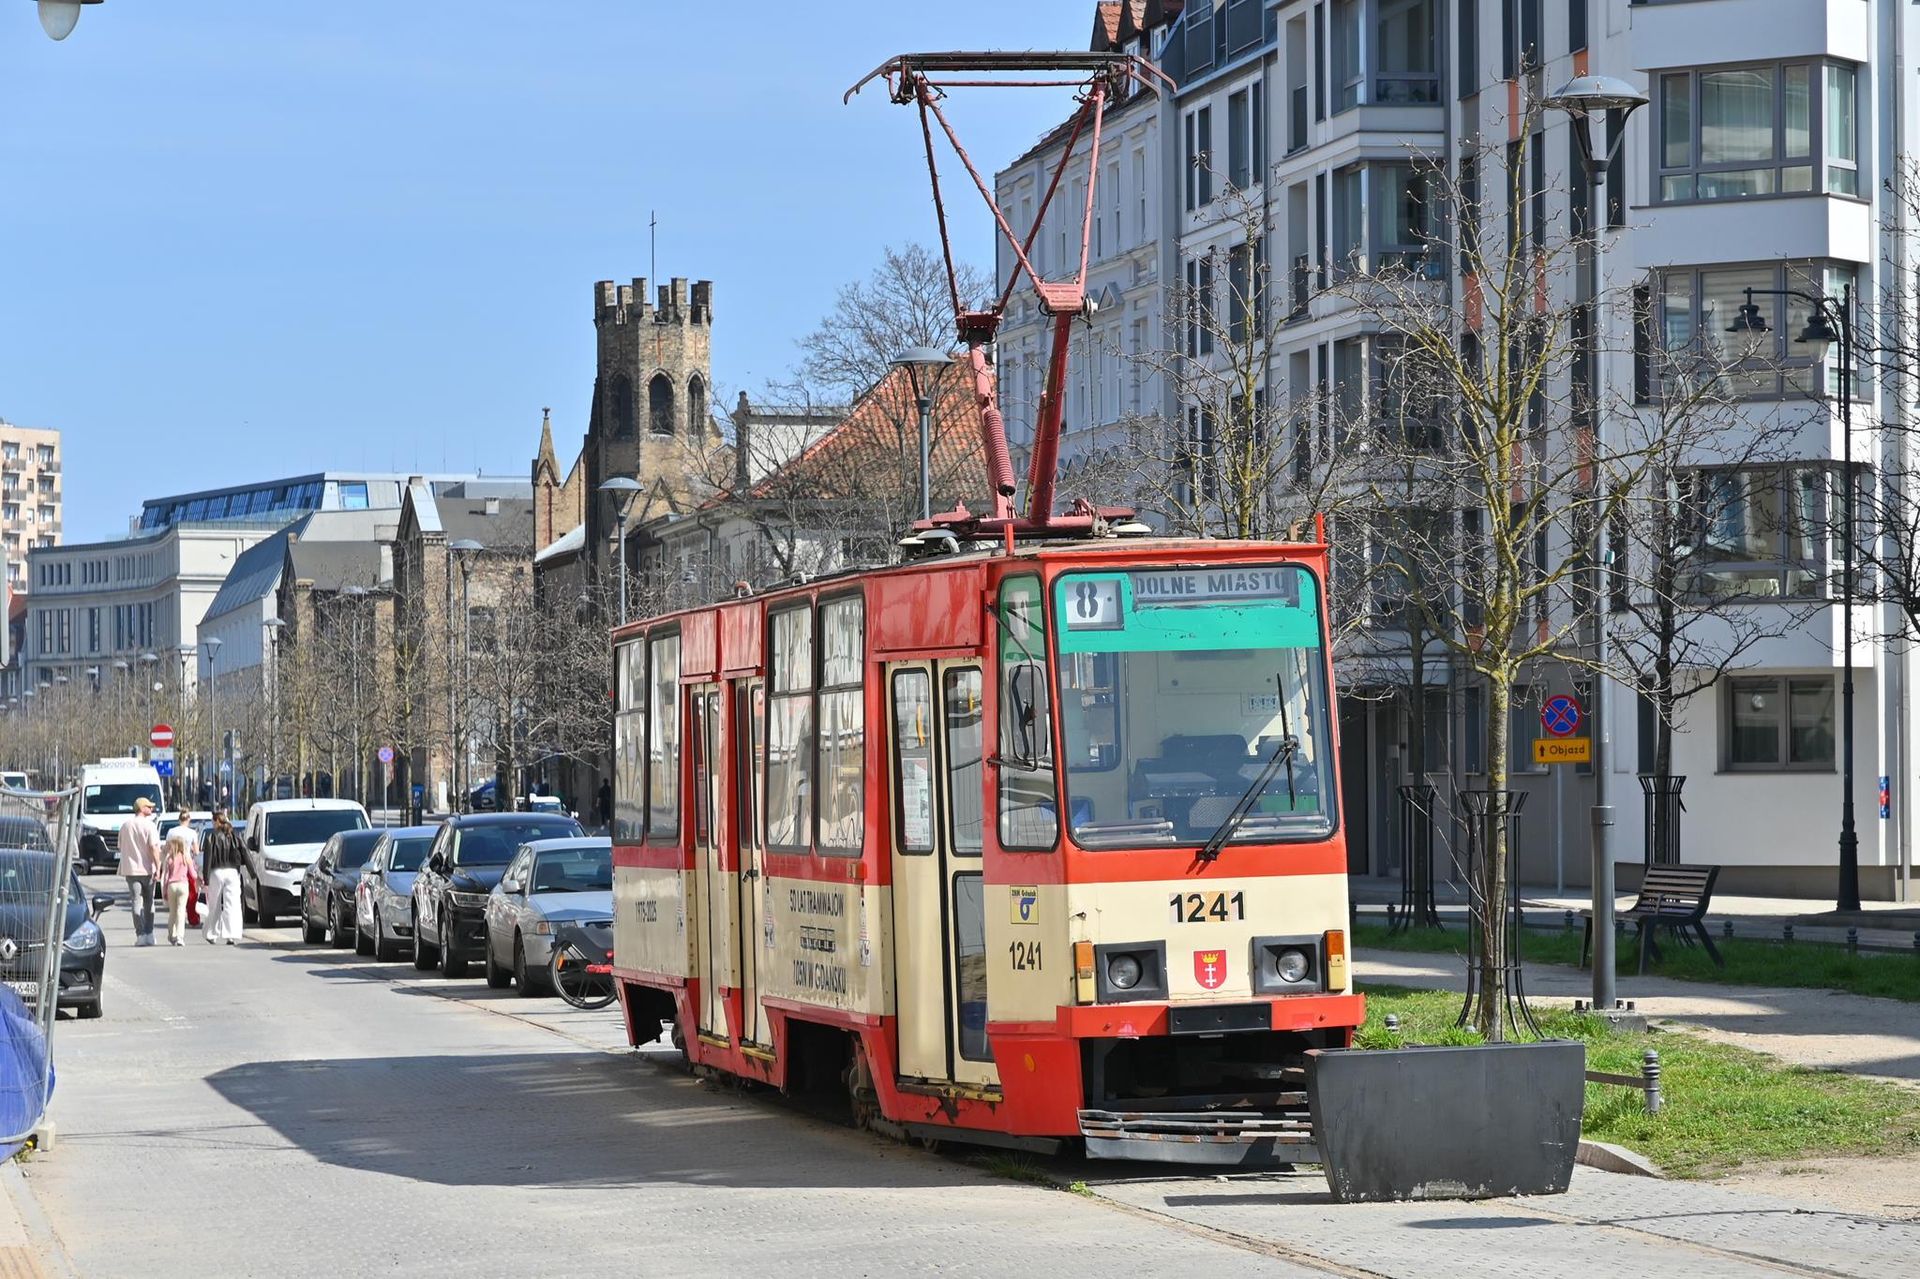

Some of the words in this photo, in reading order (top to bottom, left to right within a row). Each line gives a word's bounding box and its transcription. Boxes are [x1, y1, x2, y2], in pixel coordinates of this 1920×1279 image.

[1076, 581, 1099, 618] 8
[1136, 576, 1196, 594] DOLNE
[1550, 745, 1585, 756] Objazd
[1170, 892, 1245, 922] 1241
[1009, 941, 1041, 970] 1241
[815, 957, 846, 994] GDAŃSKU
